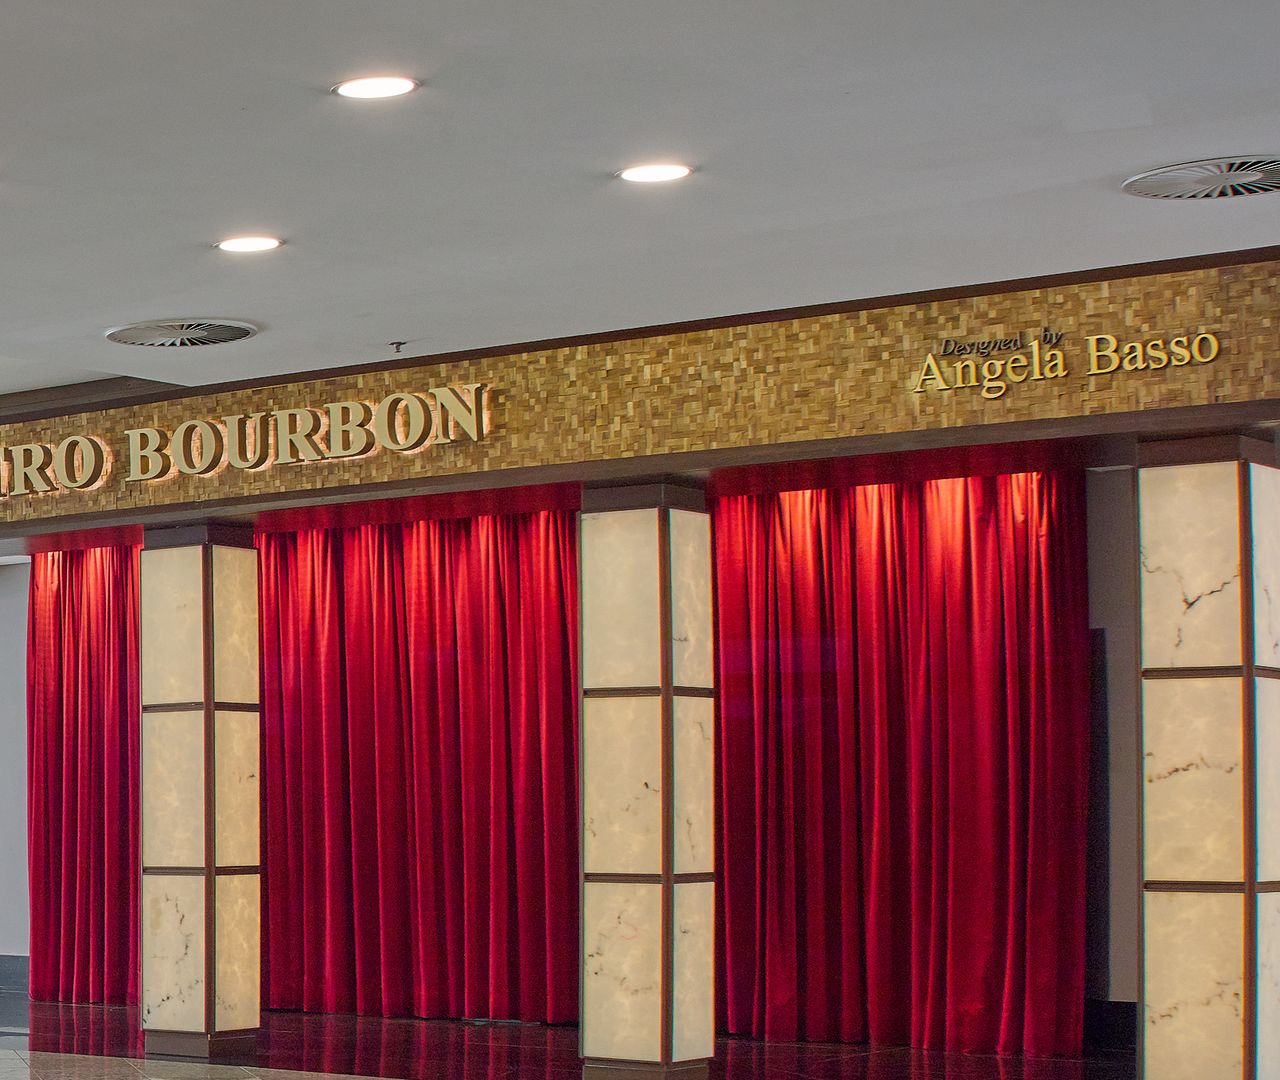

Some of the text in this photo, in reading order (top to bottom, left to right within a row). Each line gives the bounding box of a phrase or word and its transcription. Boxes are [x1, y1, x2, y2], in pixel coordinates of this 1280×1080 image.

[913, 332, 1220, 399] Angela Basso
[939, 326, 1063, 358] Designed by
[124, 383, 492, 483] BOURBON
